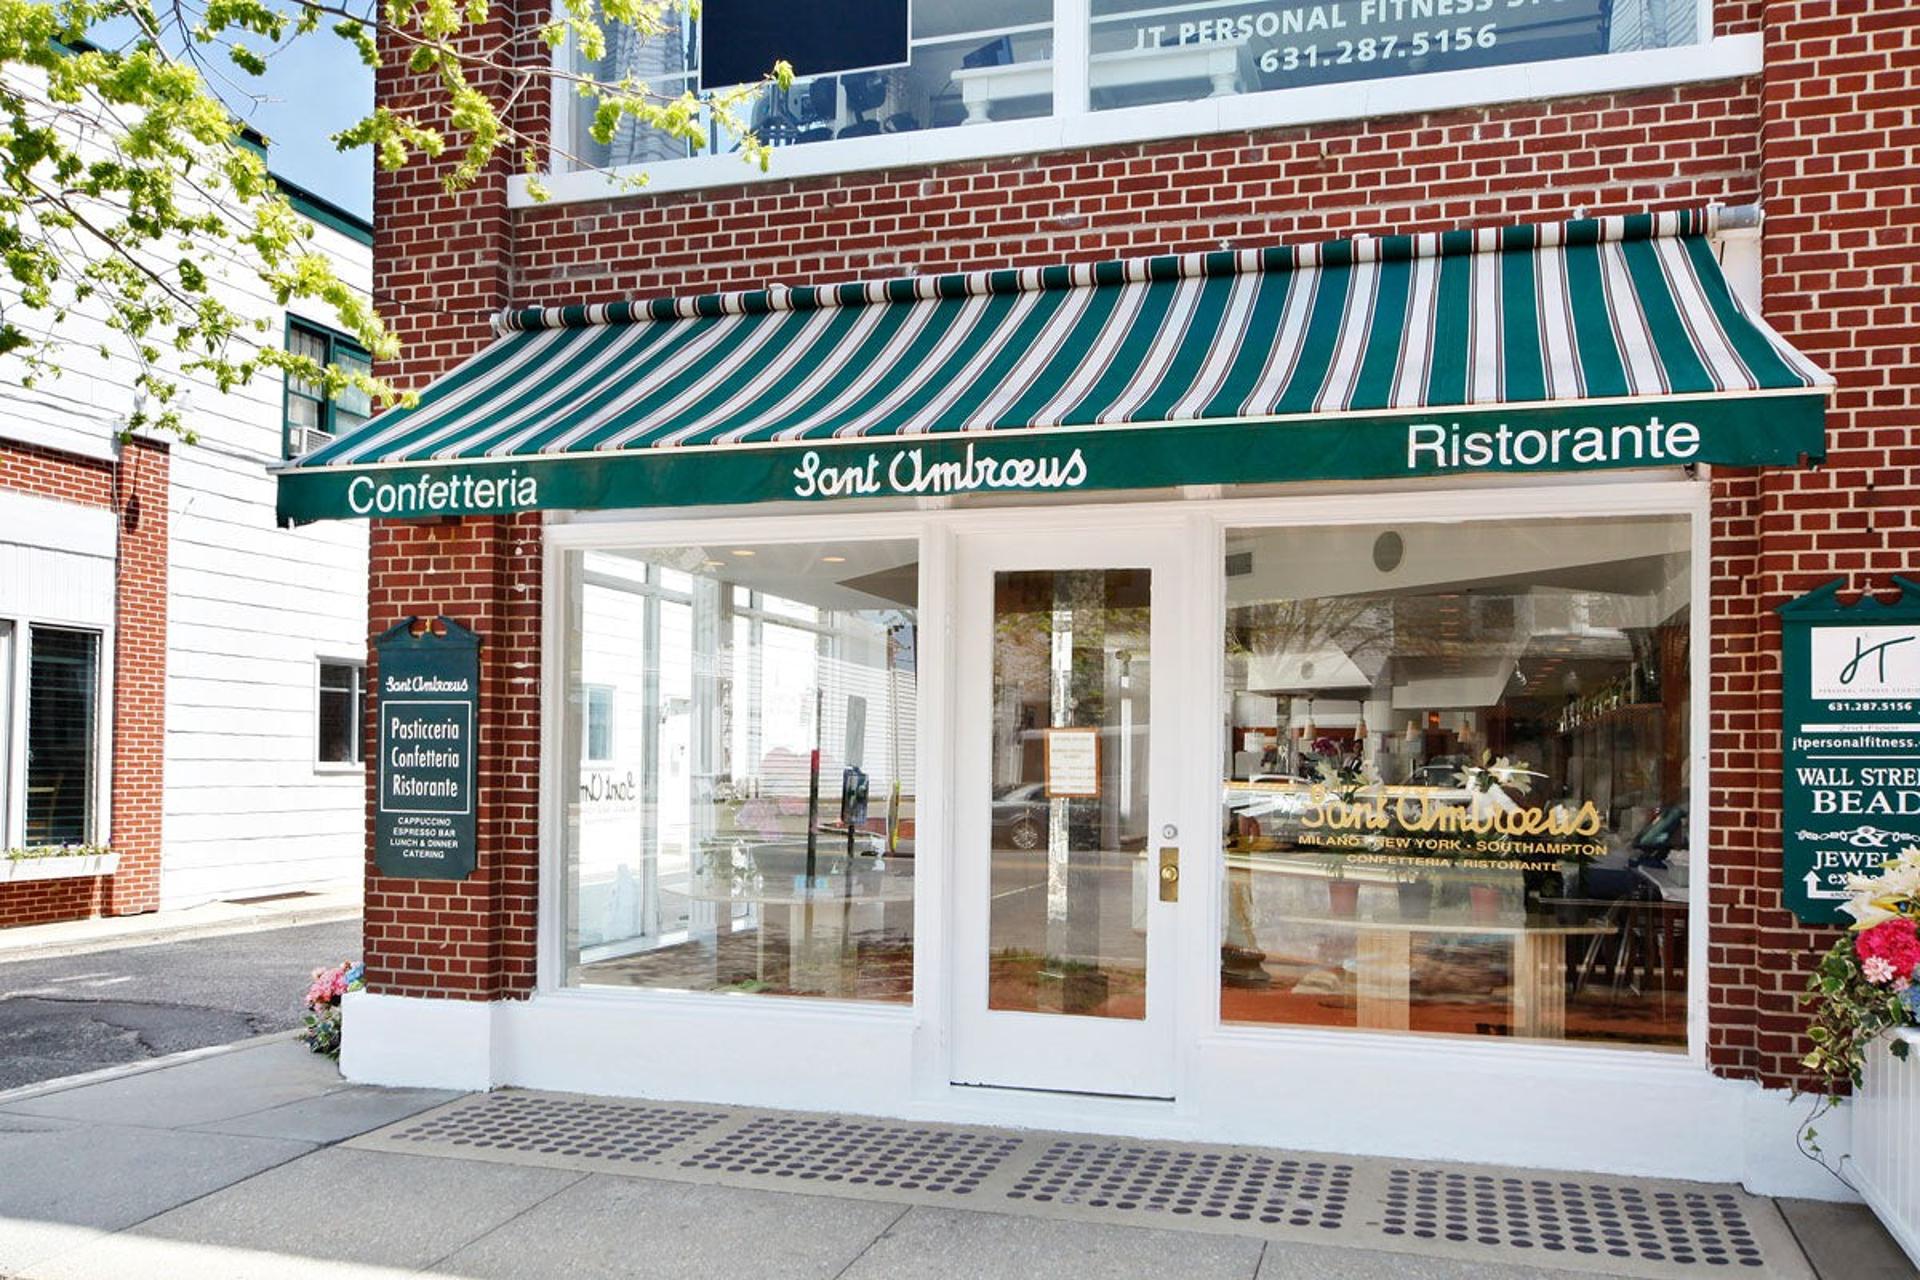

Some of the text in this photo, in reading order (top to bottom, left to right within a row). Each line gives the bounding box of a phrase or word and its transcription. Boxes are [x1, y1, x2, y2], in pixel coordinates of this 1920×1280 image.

[1179, 4, 1346, 47] PERSONAL
[1260, 23, 1497, 73] 631.287.5156
[1407, 416, 1699, 469] Ristorante
[793, 450, 880, 496] Sant
[348, 468, 538, 514] Confetteria
[385, 675, 412, 692] Sant
[1828, 702, 1913, 711] 631.287.5156
[391, 717, 459, 740] Pasticceria
[1792, 735, 1920, 750] jtpersonalfitness.
[391, 744, 459, 768] Confetteria
[392, 774, 458, 797] Ristorante
[1795, 767, 1920, 786] WALL STRE
[1301, 783, 1390, 830] Sant
[392, 826, 456, 838] ESPRESSO BAR
[397, 816, 452, 826] CAPPUCCINO
[389, 838, 418, 848] LUNCH
[426, 839, 459, 849] DINNER
[402, 849, 445, 859] CATERING
[1298, 834, 1608, 857] MILANO NEW YORK SOUTHAMPTON
[1346, 853, 1563, 873] CONFETTERIA RISTORANTE
